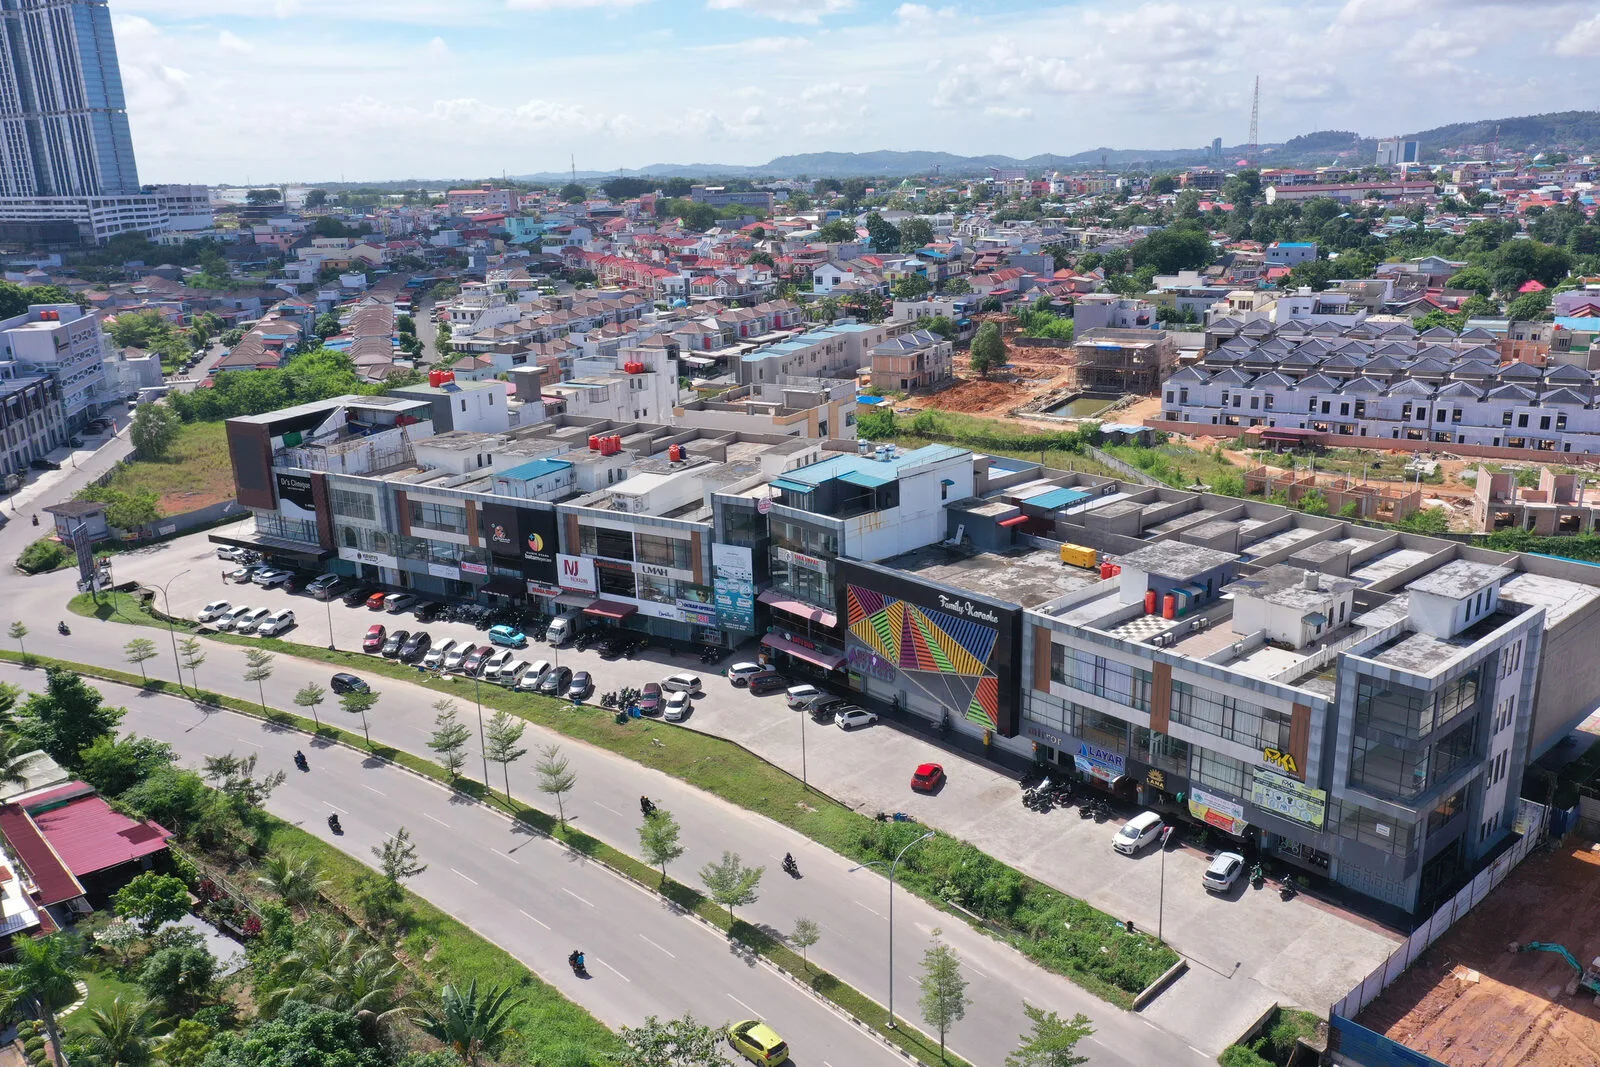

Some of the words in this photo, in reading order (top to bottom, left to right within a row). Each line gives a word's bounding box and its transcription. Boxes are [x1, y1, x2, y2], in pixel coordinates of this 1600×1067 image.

[938, 594, 965, 615] Family
[964, 601, 999, 624] Karaoke
[1088, 746, 1122, 767] LAYAR
[1146, 777, 1164, 789] LANA
